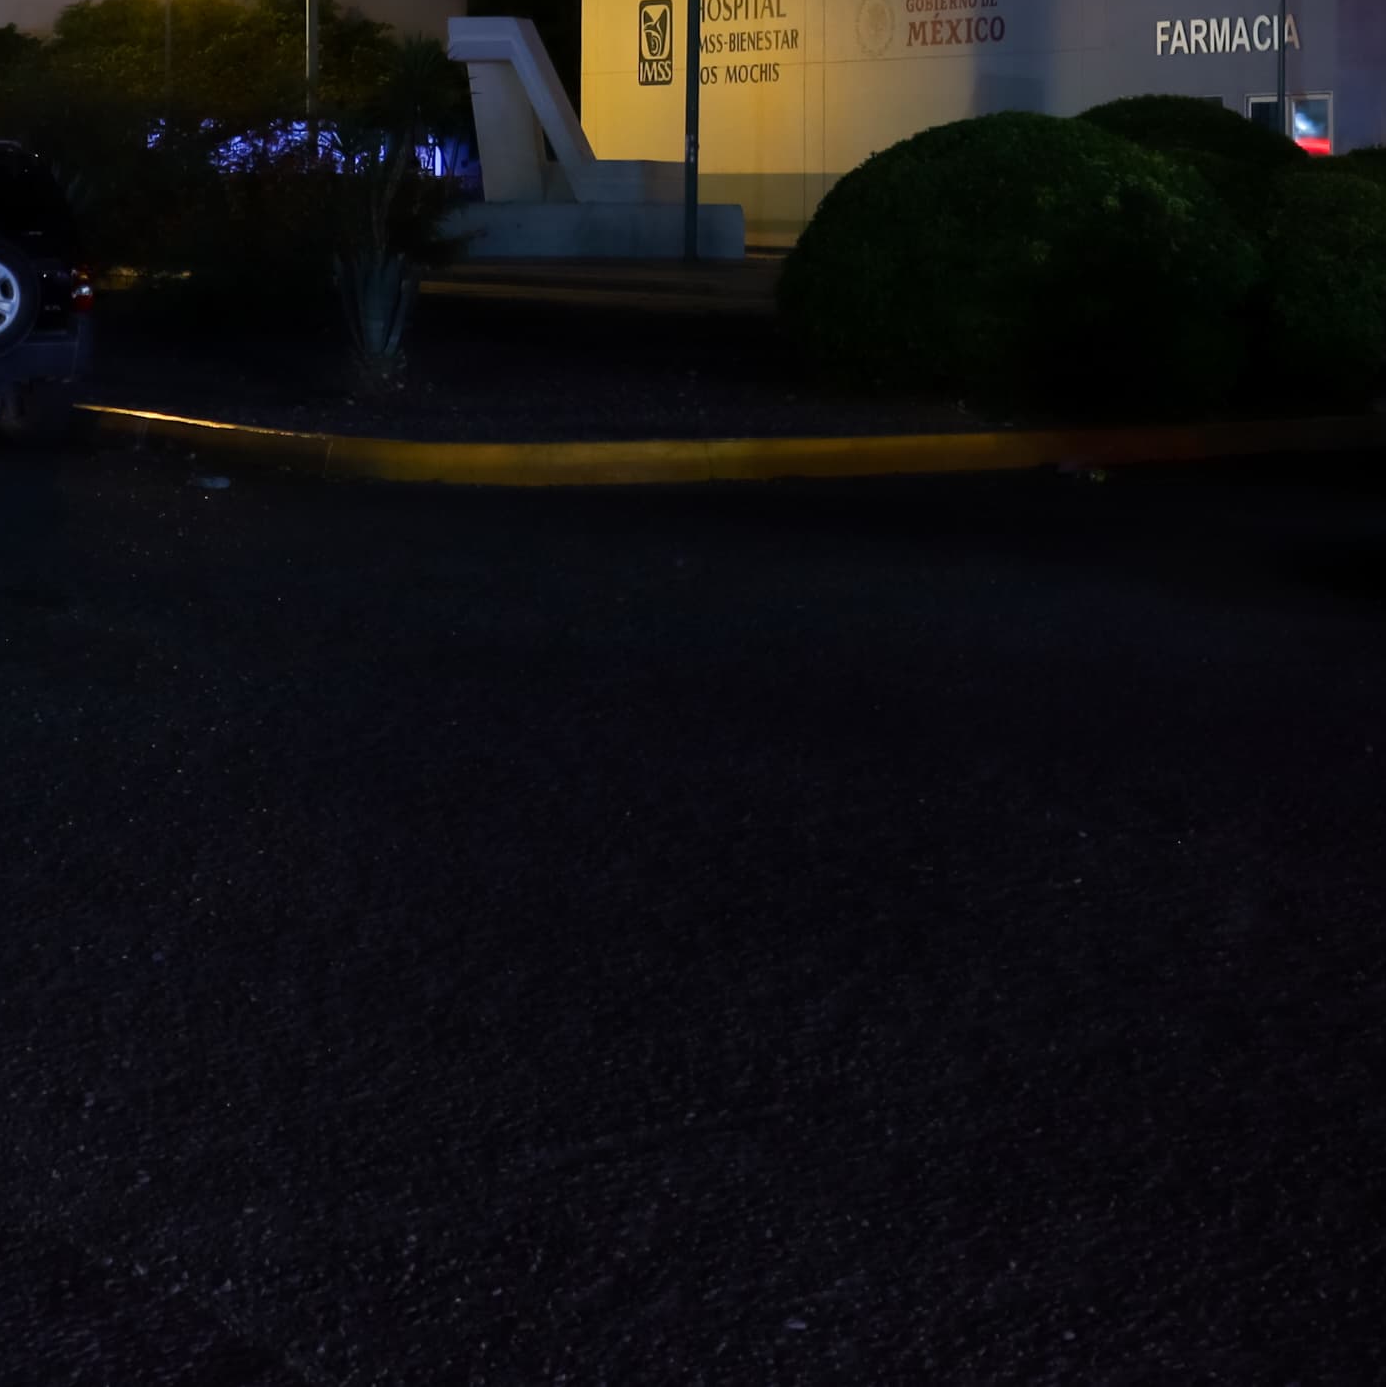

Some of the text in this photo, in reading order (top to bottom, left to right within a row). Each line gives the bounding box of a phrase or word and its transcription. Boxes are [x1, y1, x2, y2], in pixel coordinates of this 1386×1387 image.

[699, 29, 799, 53] MSS-BIENESTAR
[906, 13, 1006, 47] MÉXICO
[1156, 14, 1300, 55] FARMACIA
[640, 61, 672, 83] IMSS
[700, 63, 780, 85] OS MOCHIS
